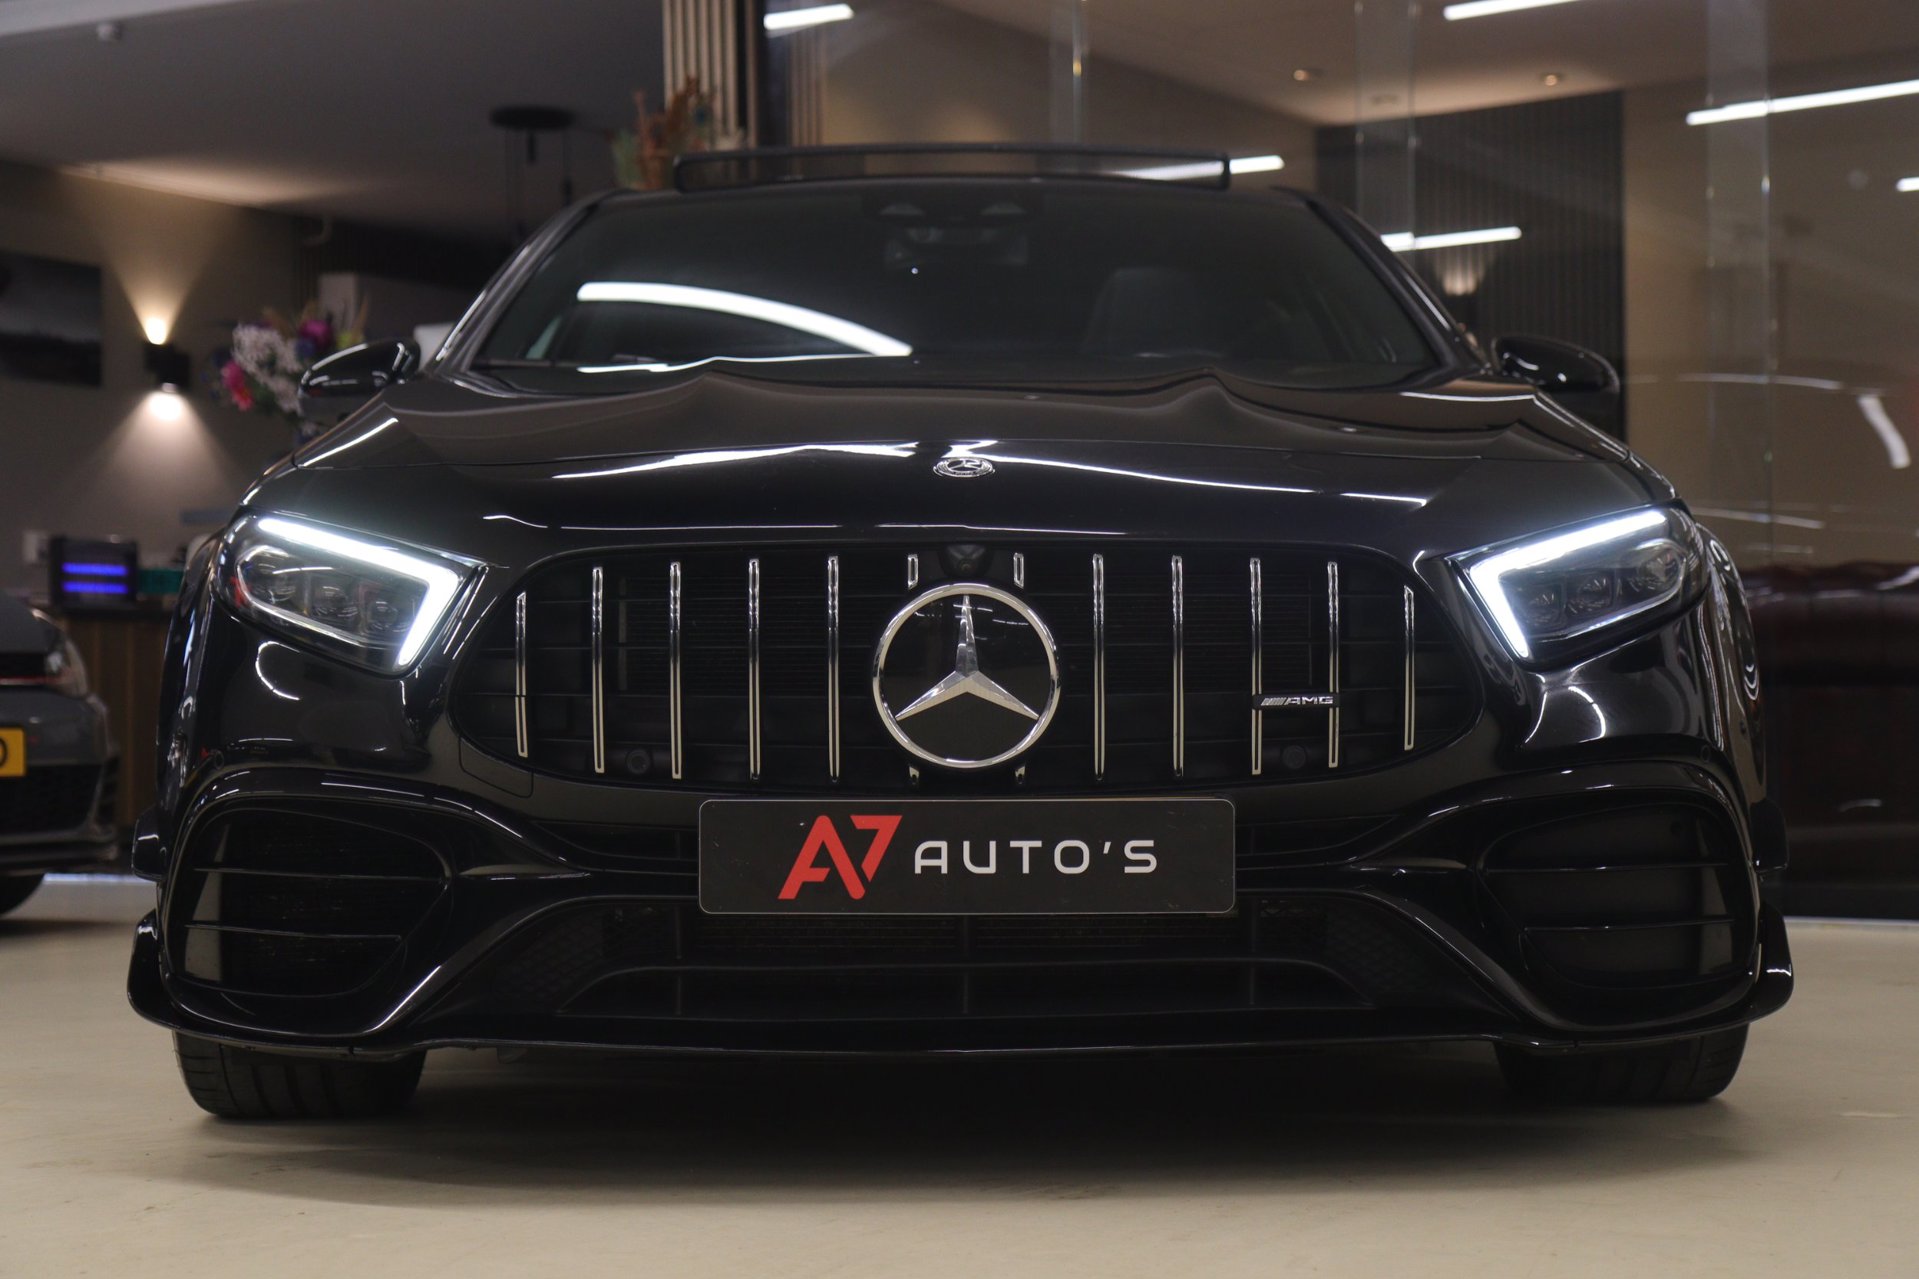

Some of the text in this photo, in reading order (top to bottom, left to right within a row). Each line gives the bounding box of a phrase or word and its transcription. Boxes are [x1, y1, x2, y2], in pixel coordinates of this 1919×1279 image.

[1284, 696, 1334, 706] AMG
[777, 814, 1158, 901] A7 AUTO'S
